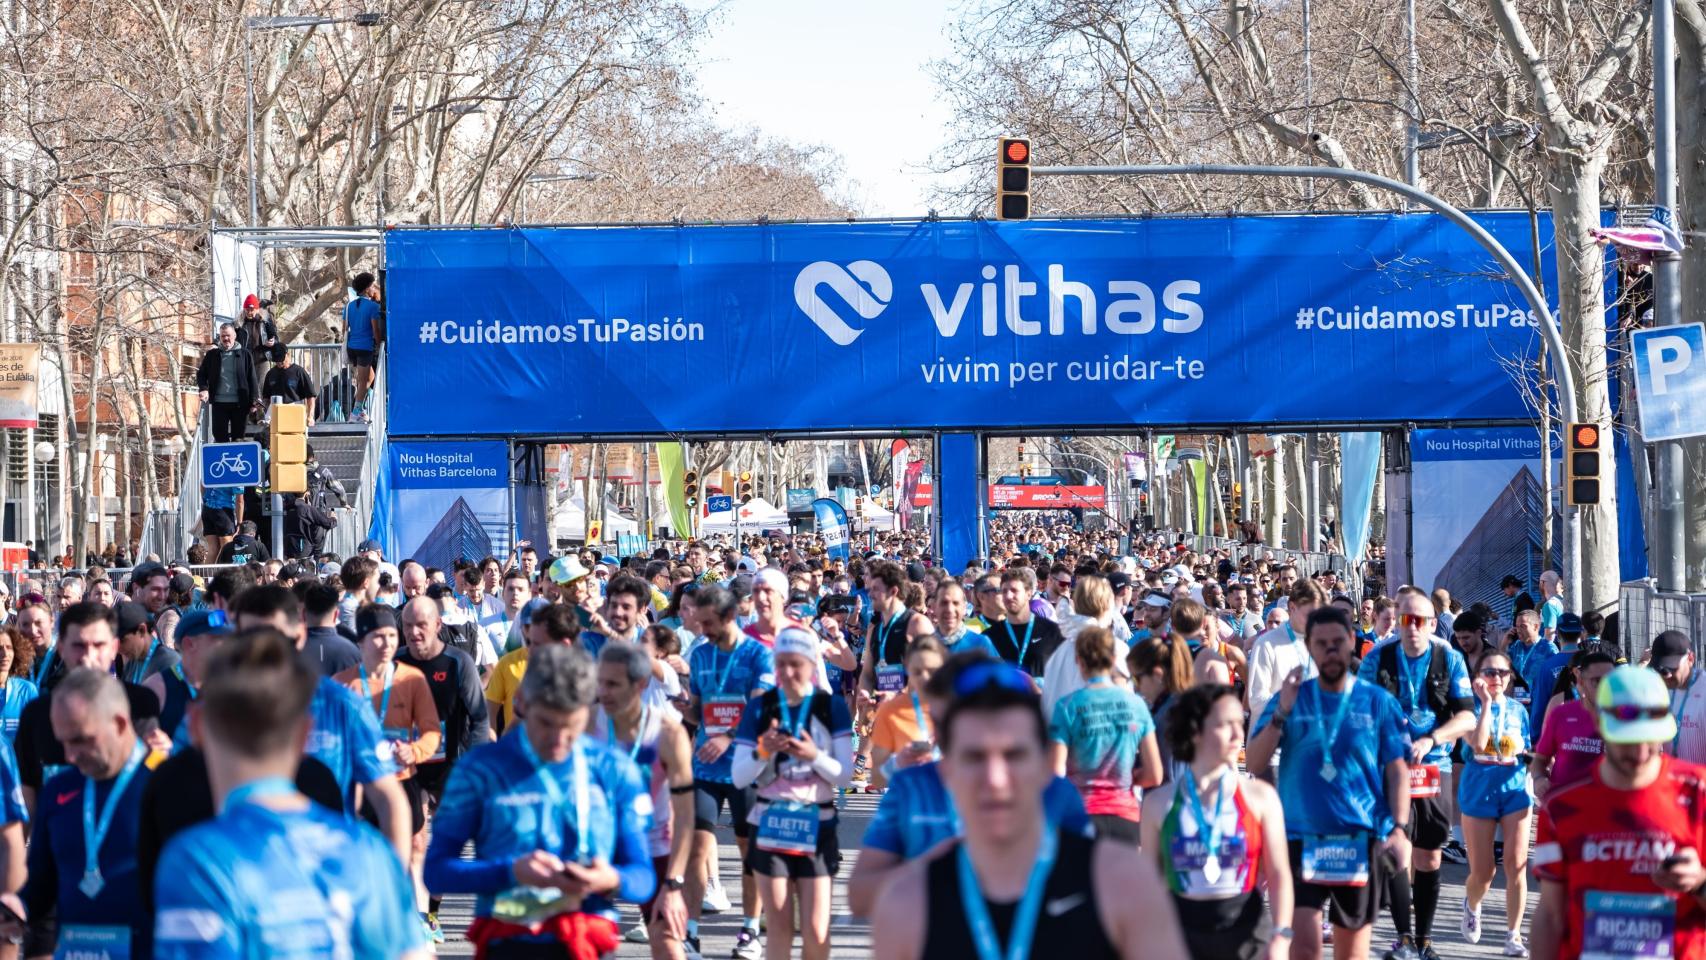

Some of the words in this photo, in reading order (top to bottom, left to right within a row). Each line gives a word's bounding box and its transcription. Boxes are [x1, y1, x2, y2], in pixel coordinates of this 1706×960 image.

[920, 263, 1204, 337] vithas
[1295, 304, 1560, 330] #CuidamosTuPas
[419, 316, 704, 344] #CuidamosTuPasión
[11, 362, 24, 371] de
[921, 356, 999, 383] vivim
[1009, 362, 1056, 388] per
[1067, 354, 1204, 381] cuidar-te
[1646, 335, 1692, 396] P
[1426, 440, 1450, 451] Nou
[1452, 438, 1500, 452] Hospital
[1502, 437, 1540, 449] Vithas
[400, 453, 423, 464] Nou
[425, 452, 473, 466] Hospital
[400, 466, 437, 478] Vithas
[439, 465, 497, 477] Barcelona
[713, 706, 741, 717] MARC
[767, 814, 811, 833] ELIETTE
[1184, 839, 1230, 858] MAE
[1313, 846, 1358, 861] BRUNO
[1596, 917, 1663, 941] RICARD
